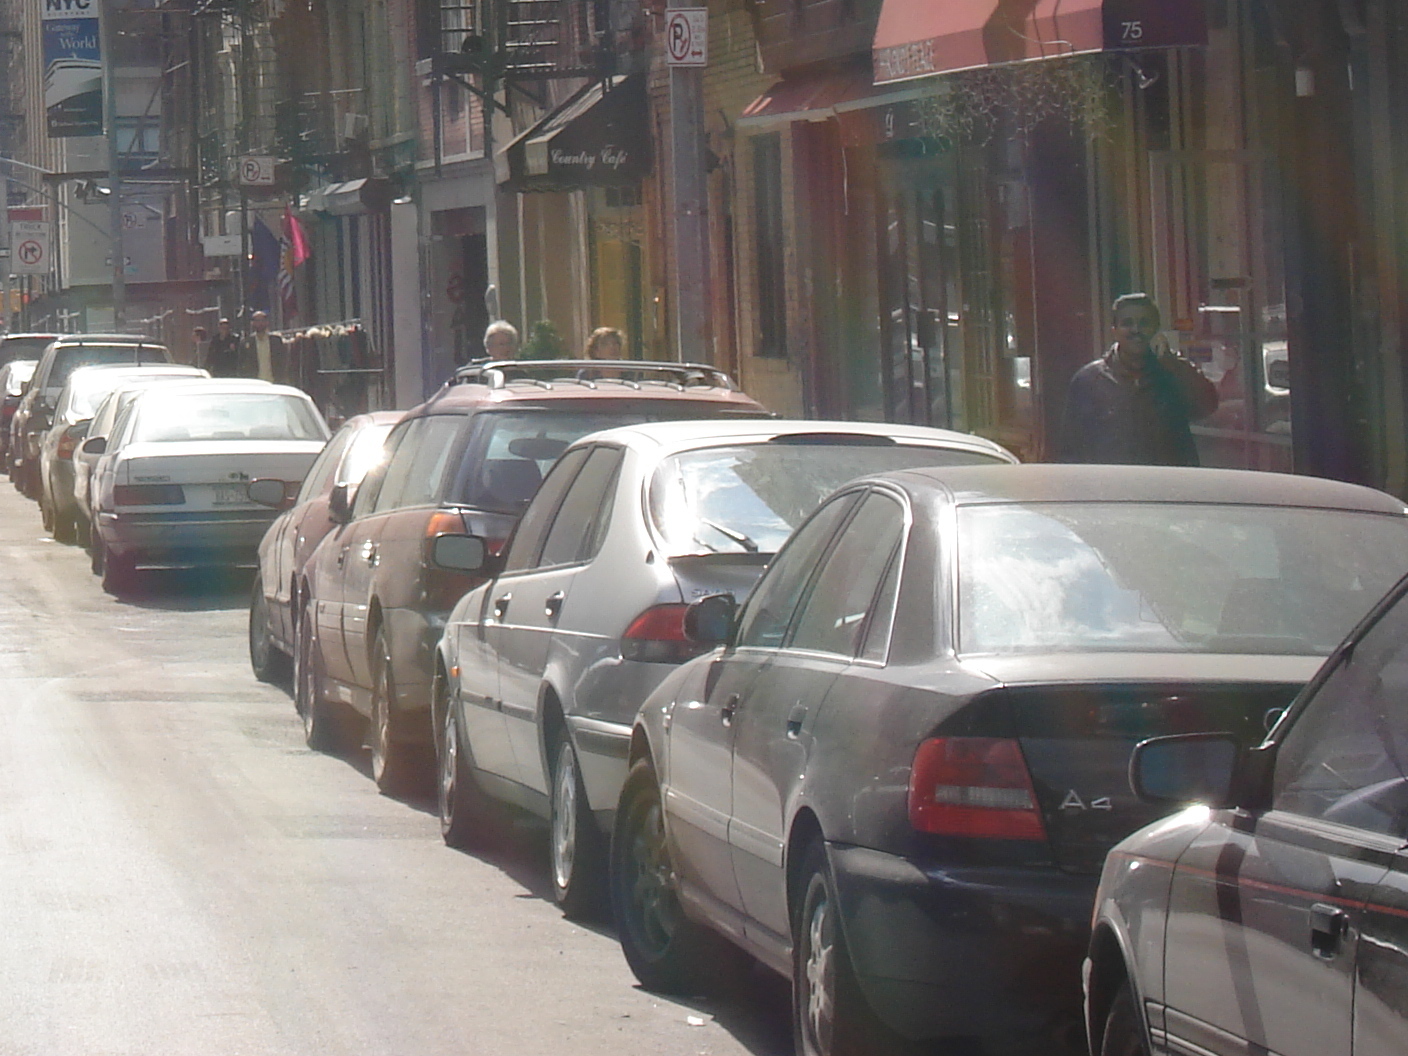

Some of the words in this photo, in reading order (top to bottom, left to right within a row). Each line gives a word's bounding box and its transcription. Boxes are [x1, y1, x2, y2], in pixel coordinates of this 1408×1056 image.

[1121, 21, 1143, 39] 75
[59, 35, 96, 49] World
[551, 149, 596, 170] Country
[1057, 789, 1112, 810] A4
